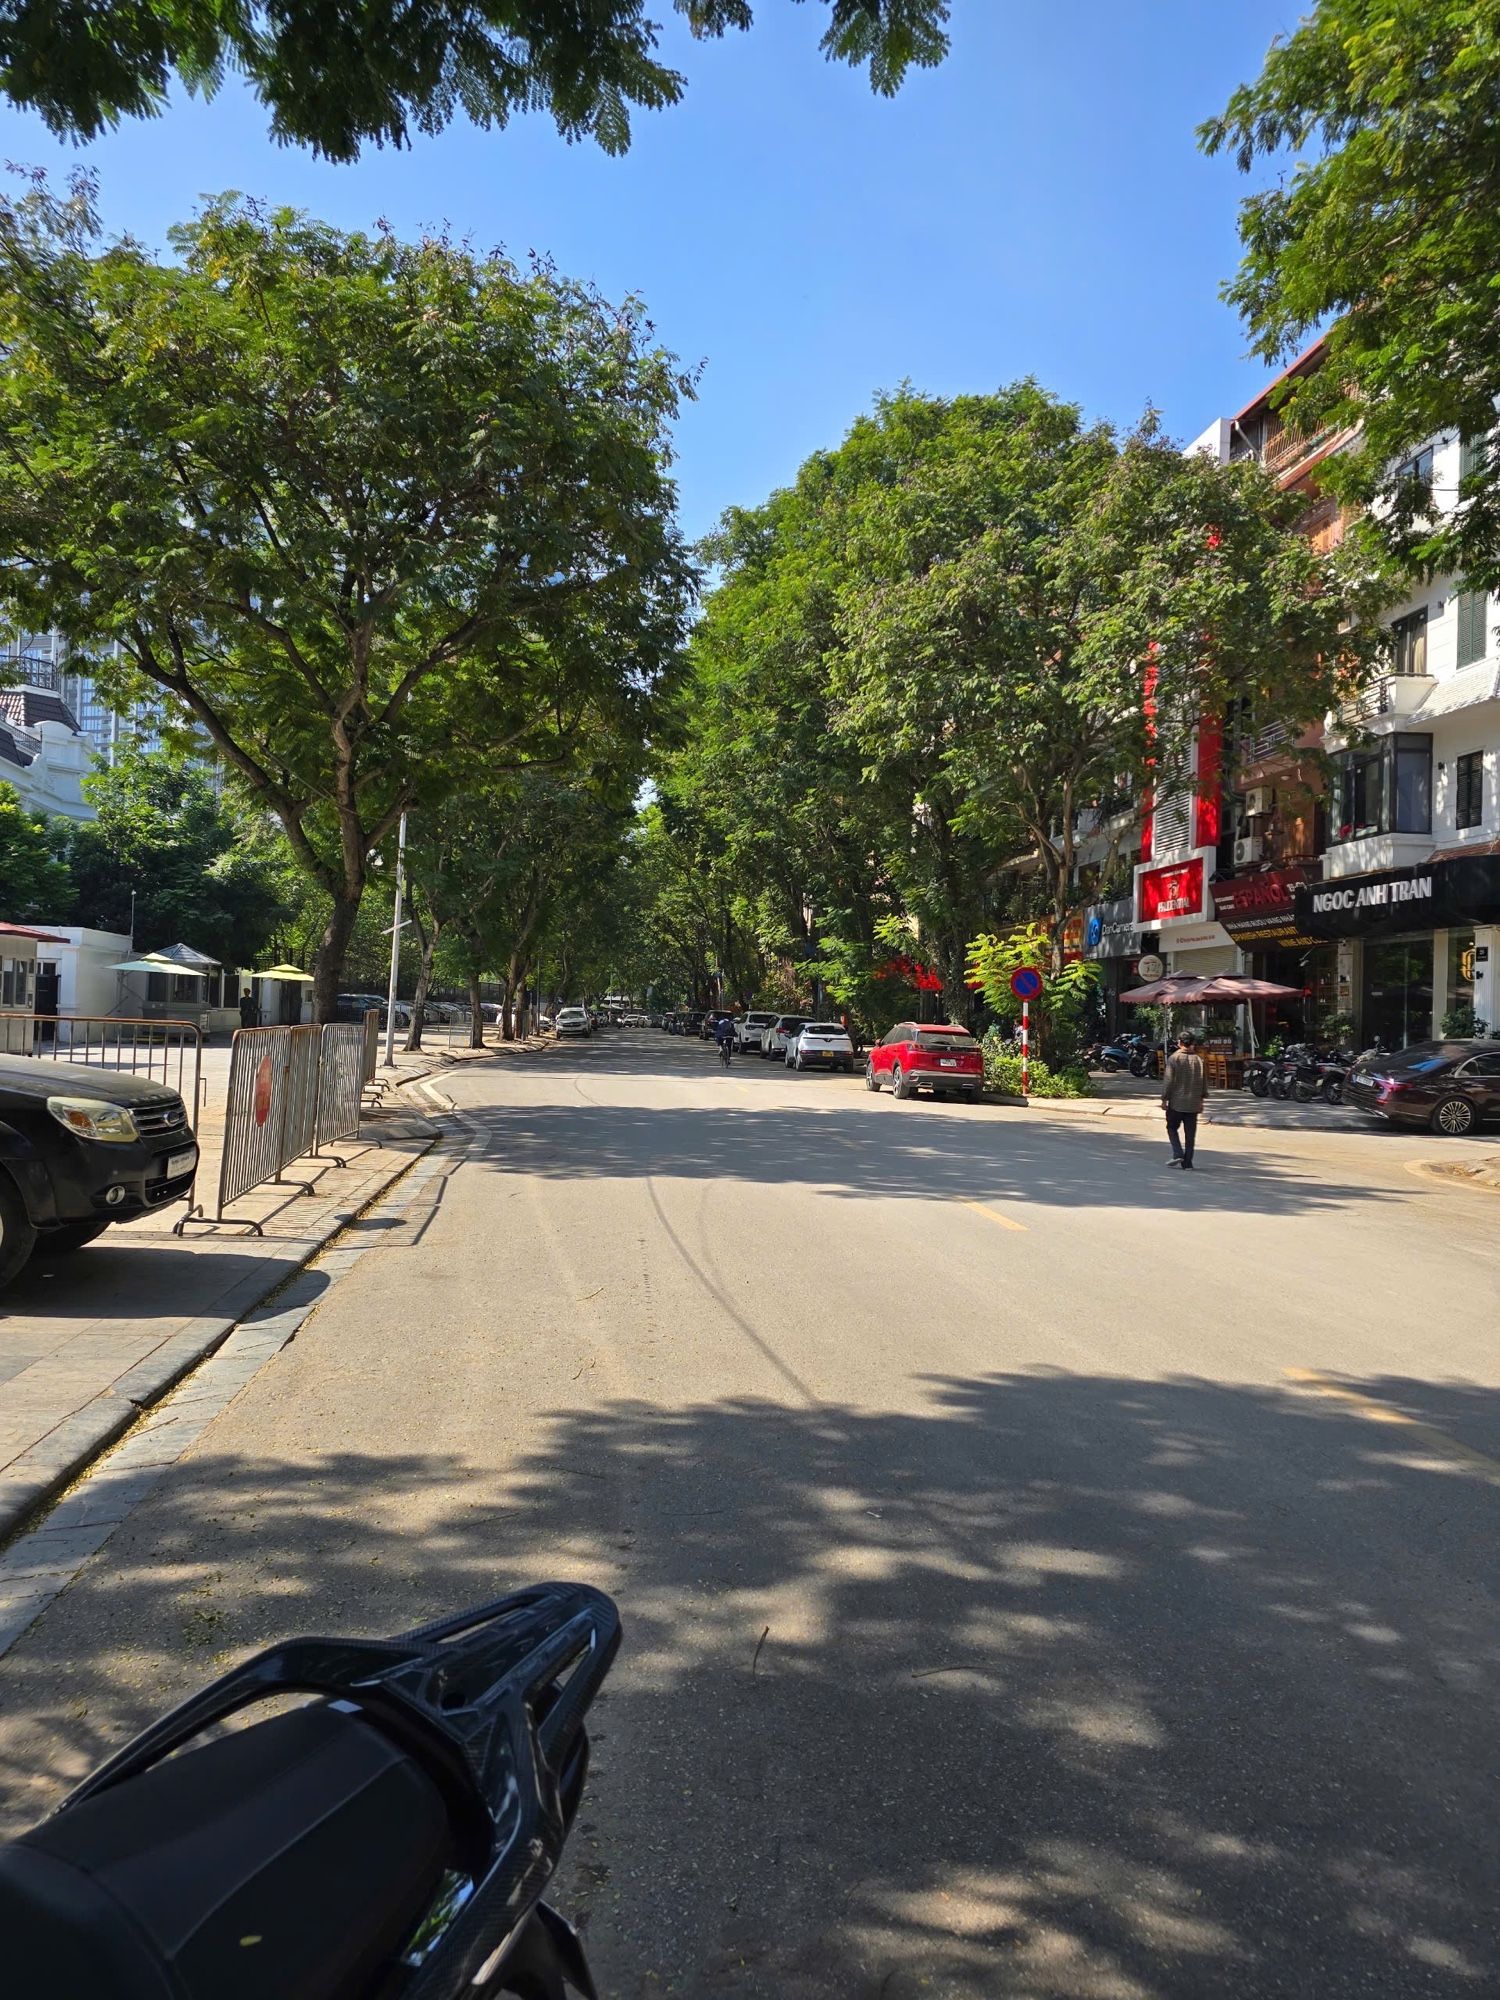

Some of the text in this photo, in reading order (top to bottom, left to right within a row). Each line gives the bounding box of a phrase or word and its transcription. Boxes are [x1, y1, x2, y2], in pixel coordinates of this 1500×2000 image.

[1313, 876, 1431, 913] NGOC ANH TRAN
